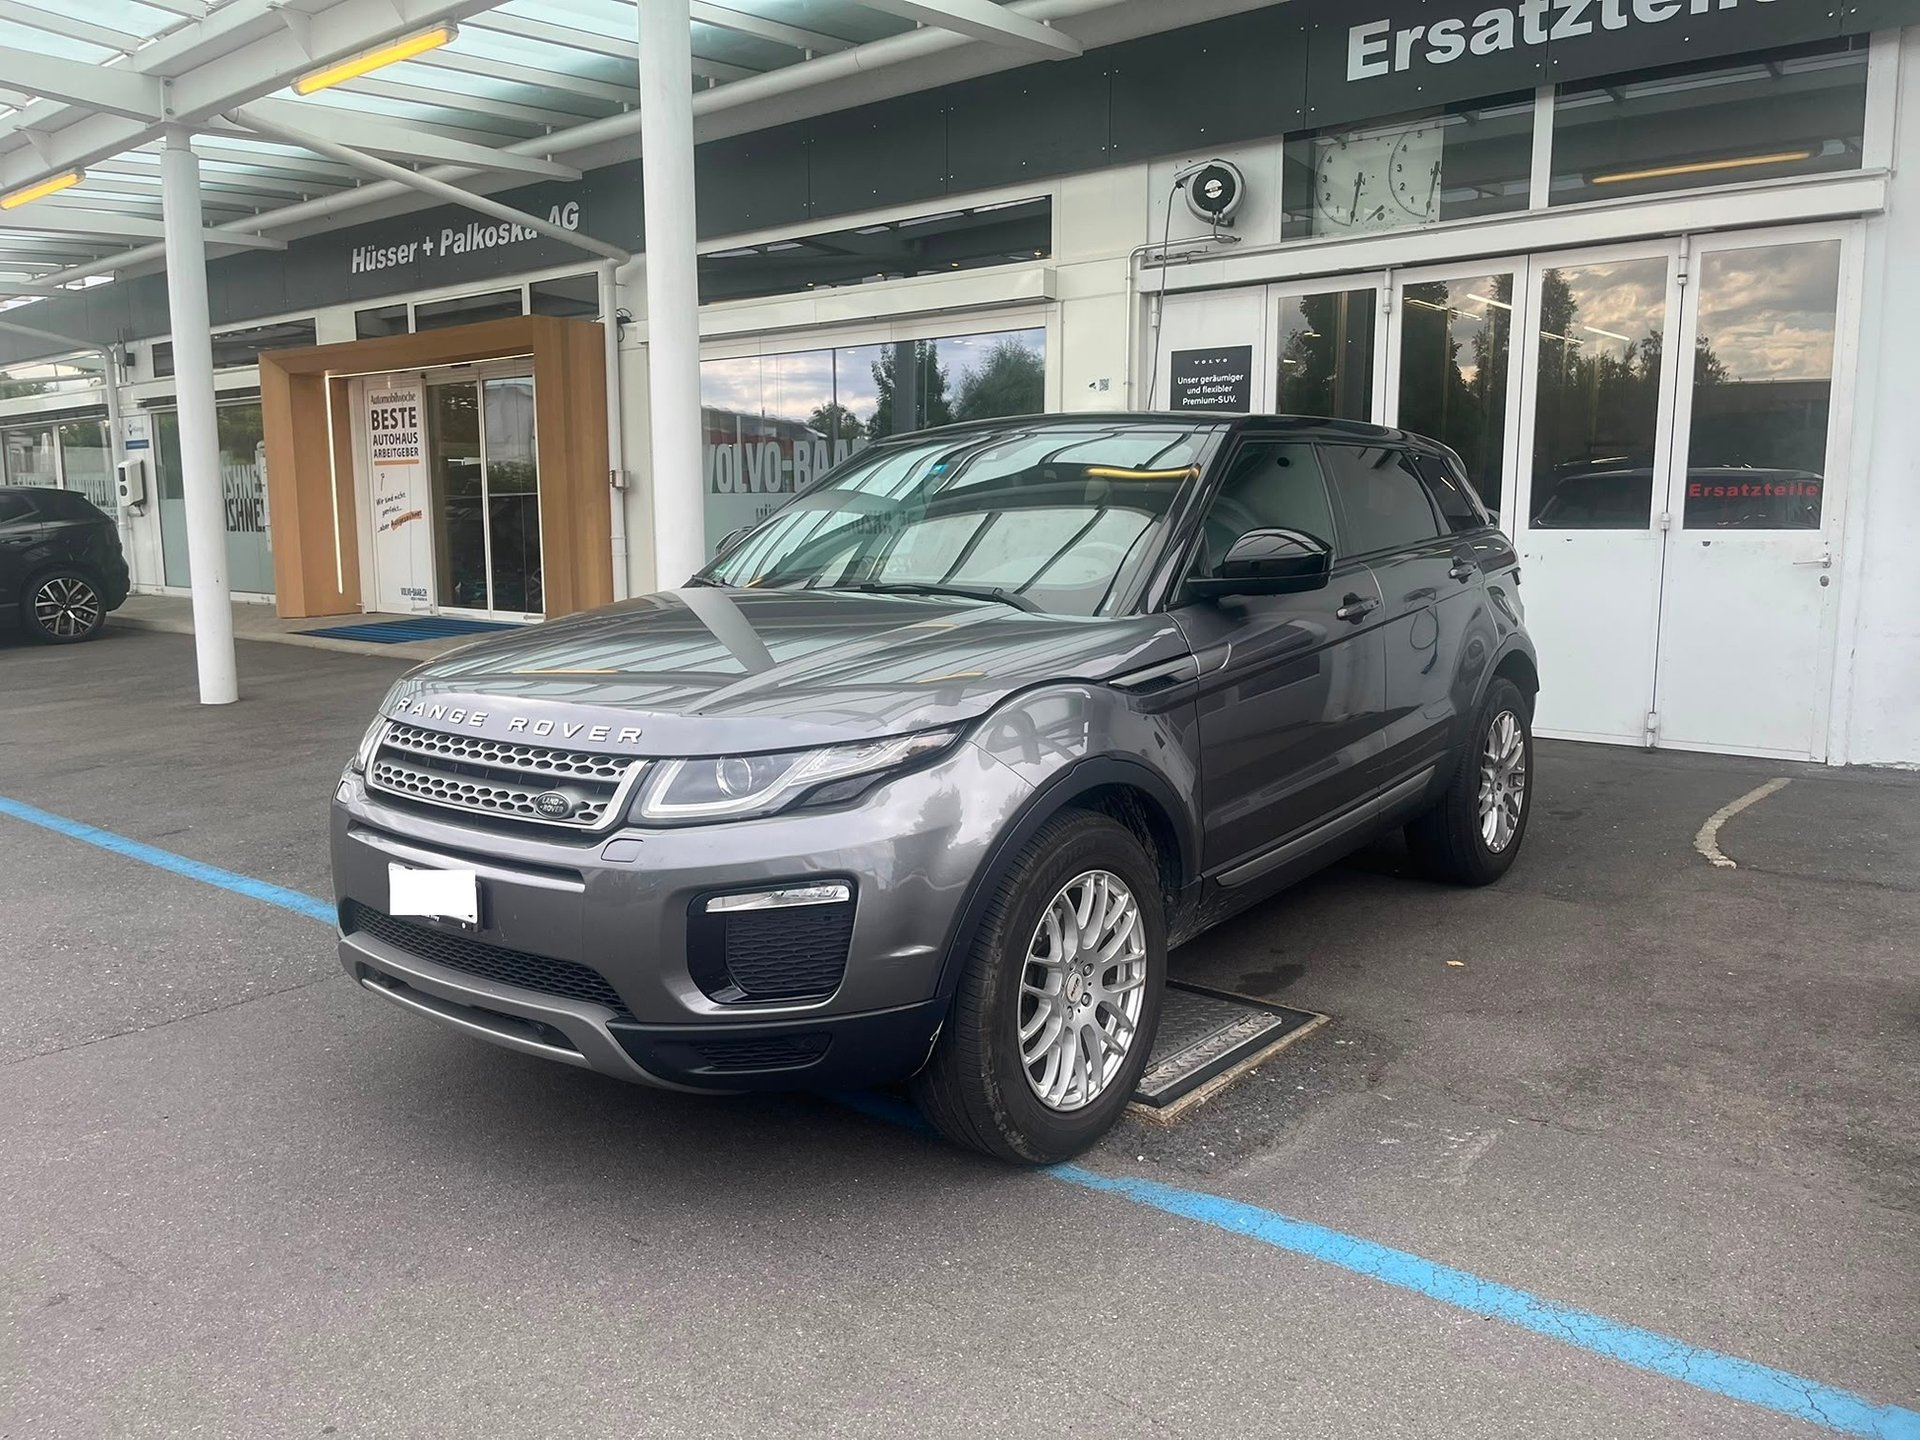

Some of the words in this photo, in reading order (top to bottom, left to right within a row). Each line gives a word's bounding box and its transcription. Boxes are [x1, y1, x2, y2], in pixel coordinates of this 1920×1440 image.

[352, 242, 417, 273] Hüsser
[547, 201, 579, 232] AG
[1177, 377, 1199, 385] Unser
[1200, 374, 1244, 385] geräumiger
[1187, 386, 1201, 395] und
[1202, 385, 1233, 393] flexibler
[1182, 395, 1237, 405] Premium-SUV.
[371, 406, 417, 431] BESTE
[372, 432, 419, 446] AUTOHAUS
[373, 447, 419, 459] ARBEITGEBER
[1688, 482, 1819, 497] Ersatzteile
[396, 697, 489, 728] RANGE
[506, 716, 642, 745] ROVER
[541, 796, 559, 806] LAND
[543, 804, 564, 813] ROVER
